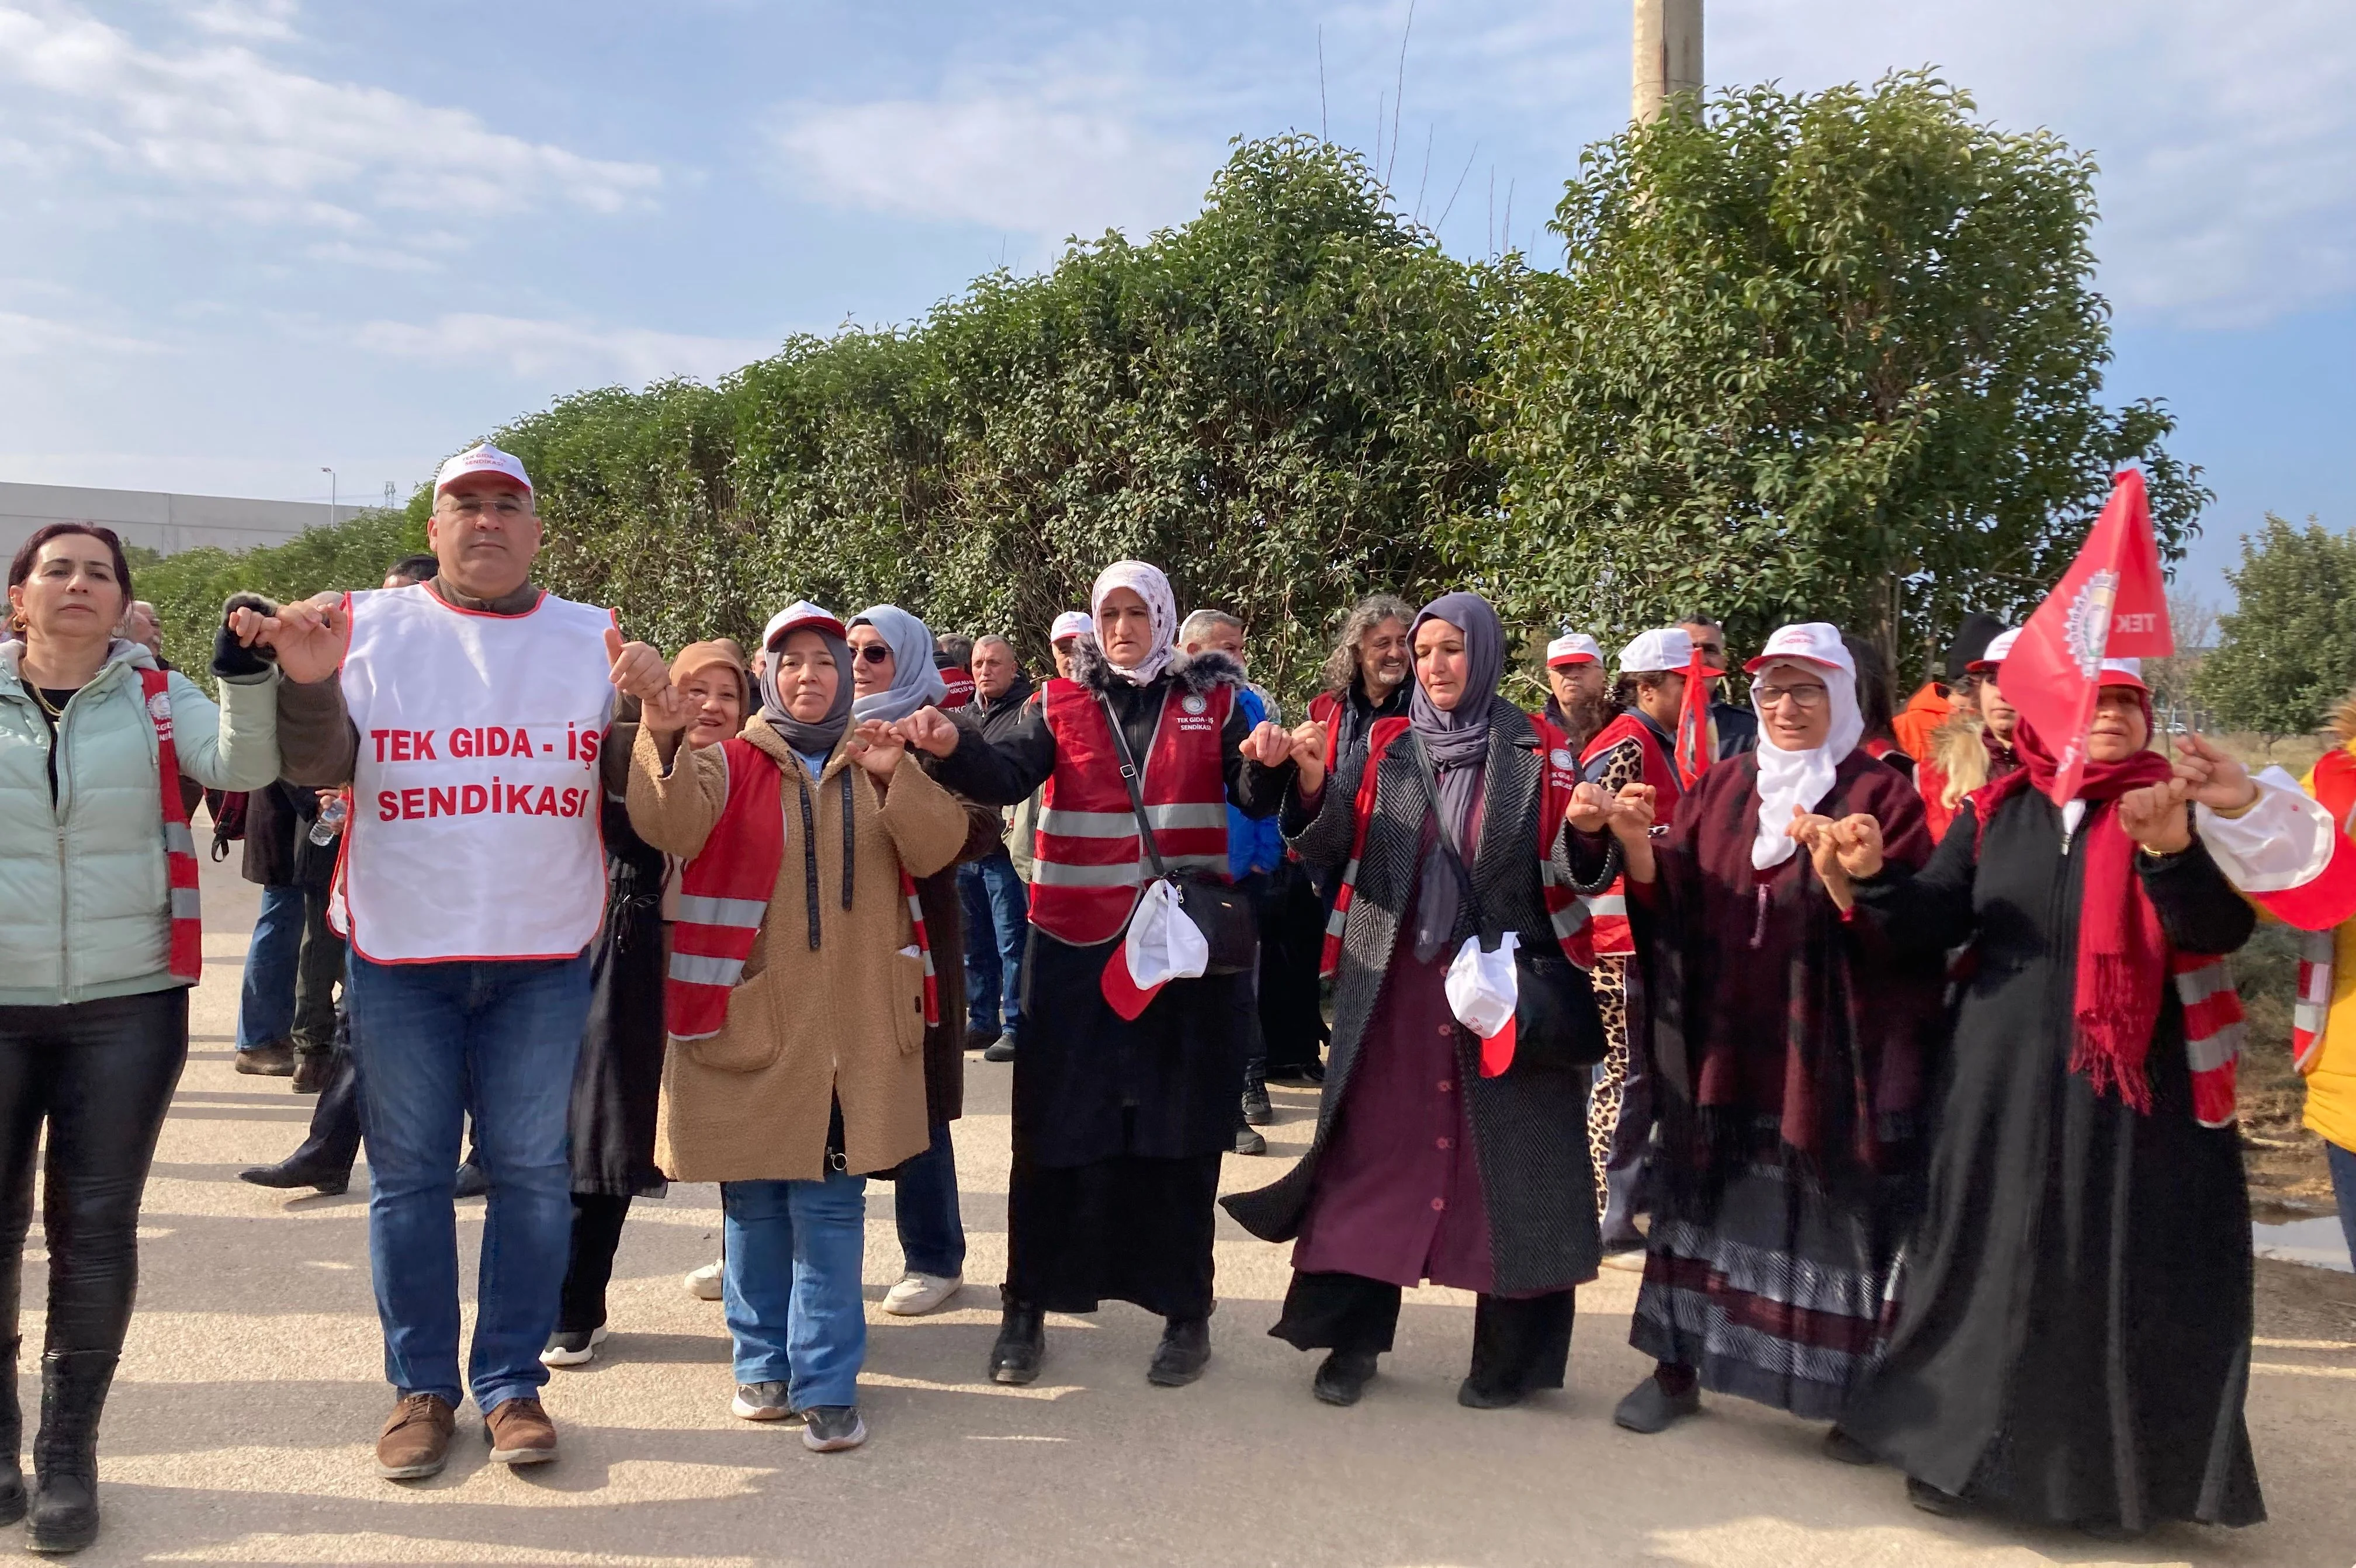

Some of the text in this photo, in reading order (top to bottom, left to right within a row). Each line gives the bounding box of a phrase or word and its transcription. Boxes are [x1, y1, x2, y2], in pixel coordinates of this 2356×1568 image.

[465, 459, 503, 467] SENDİKASI
[370, 729, 437, 762] TEK
[449, 727, 533, 758] GIDA
[568, 721, 600, 770] İŞ
[377, 776, 589, 821] SENDİKASI
